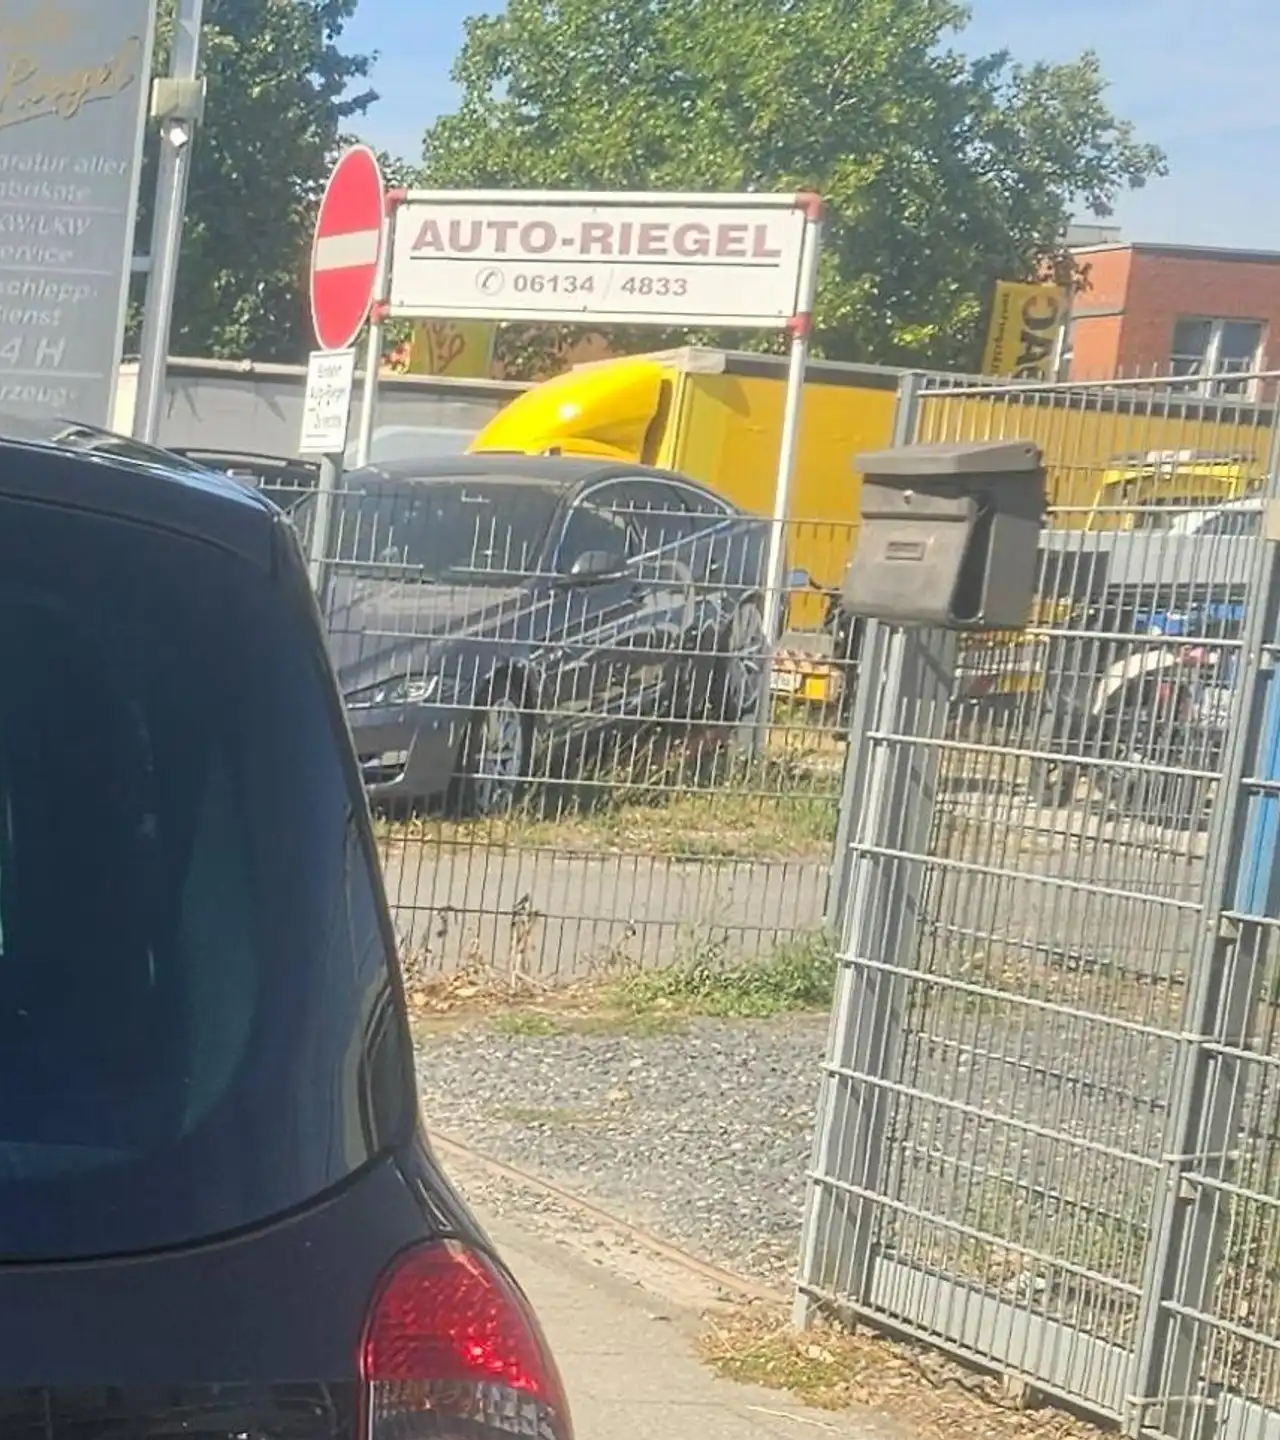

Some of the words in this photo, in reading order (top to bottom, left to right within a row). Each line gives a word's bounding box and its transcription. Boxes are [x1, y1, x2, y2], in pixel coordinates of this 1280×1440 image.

[73, 153, 127, 175] aller
[410, 219, 782, 258] AUTO-RIEGEL
[513, 273, 595, 294] 06134
[620, 275, 688, 297] 4833
[36, 336, 66, 368] H
